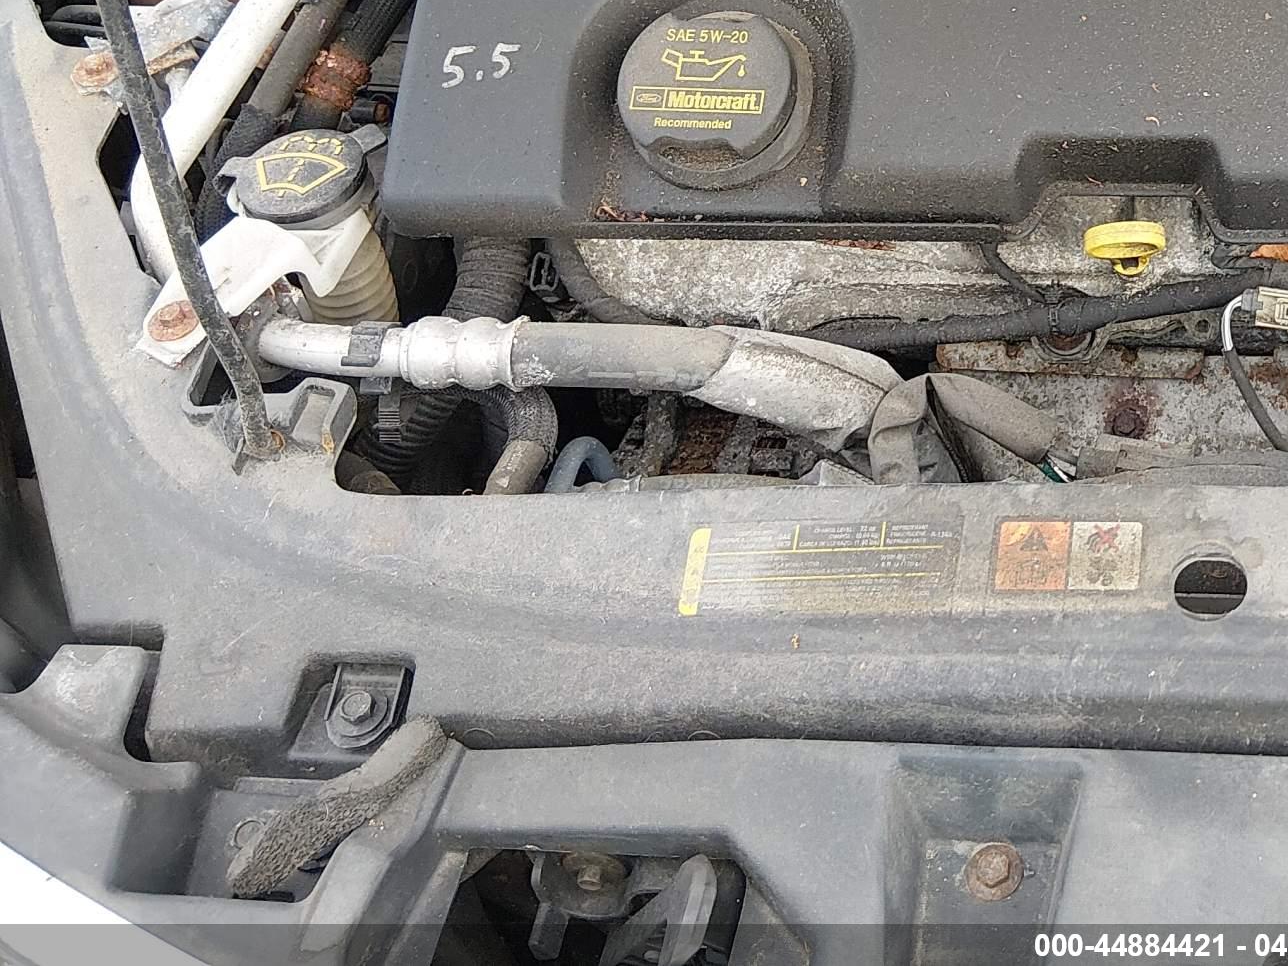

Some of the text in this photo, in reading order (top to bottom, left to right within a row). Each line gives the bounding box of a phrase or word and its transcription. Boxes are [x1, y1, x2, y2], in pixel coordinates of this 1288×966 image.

[666, 28, 749, 44] SAE 5W-20
[441, 42, 522, 89] 5.5
[654, 117, 732, 130] Recommended
